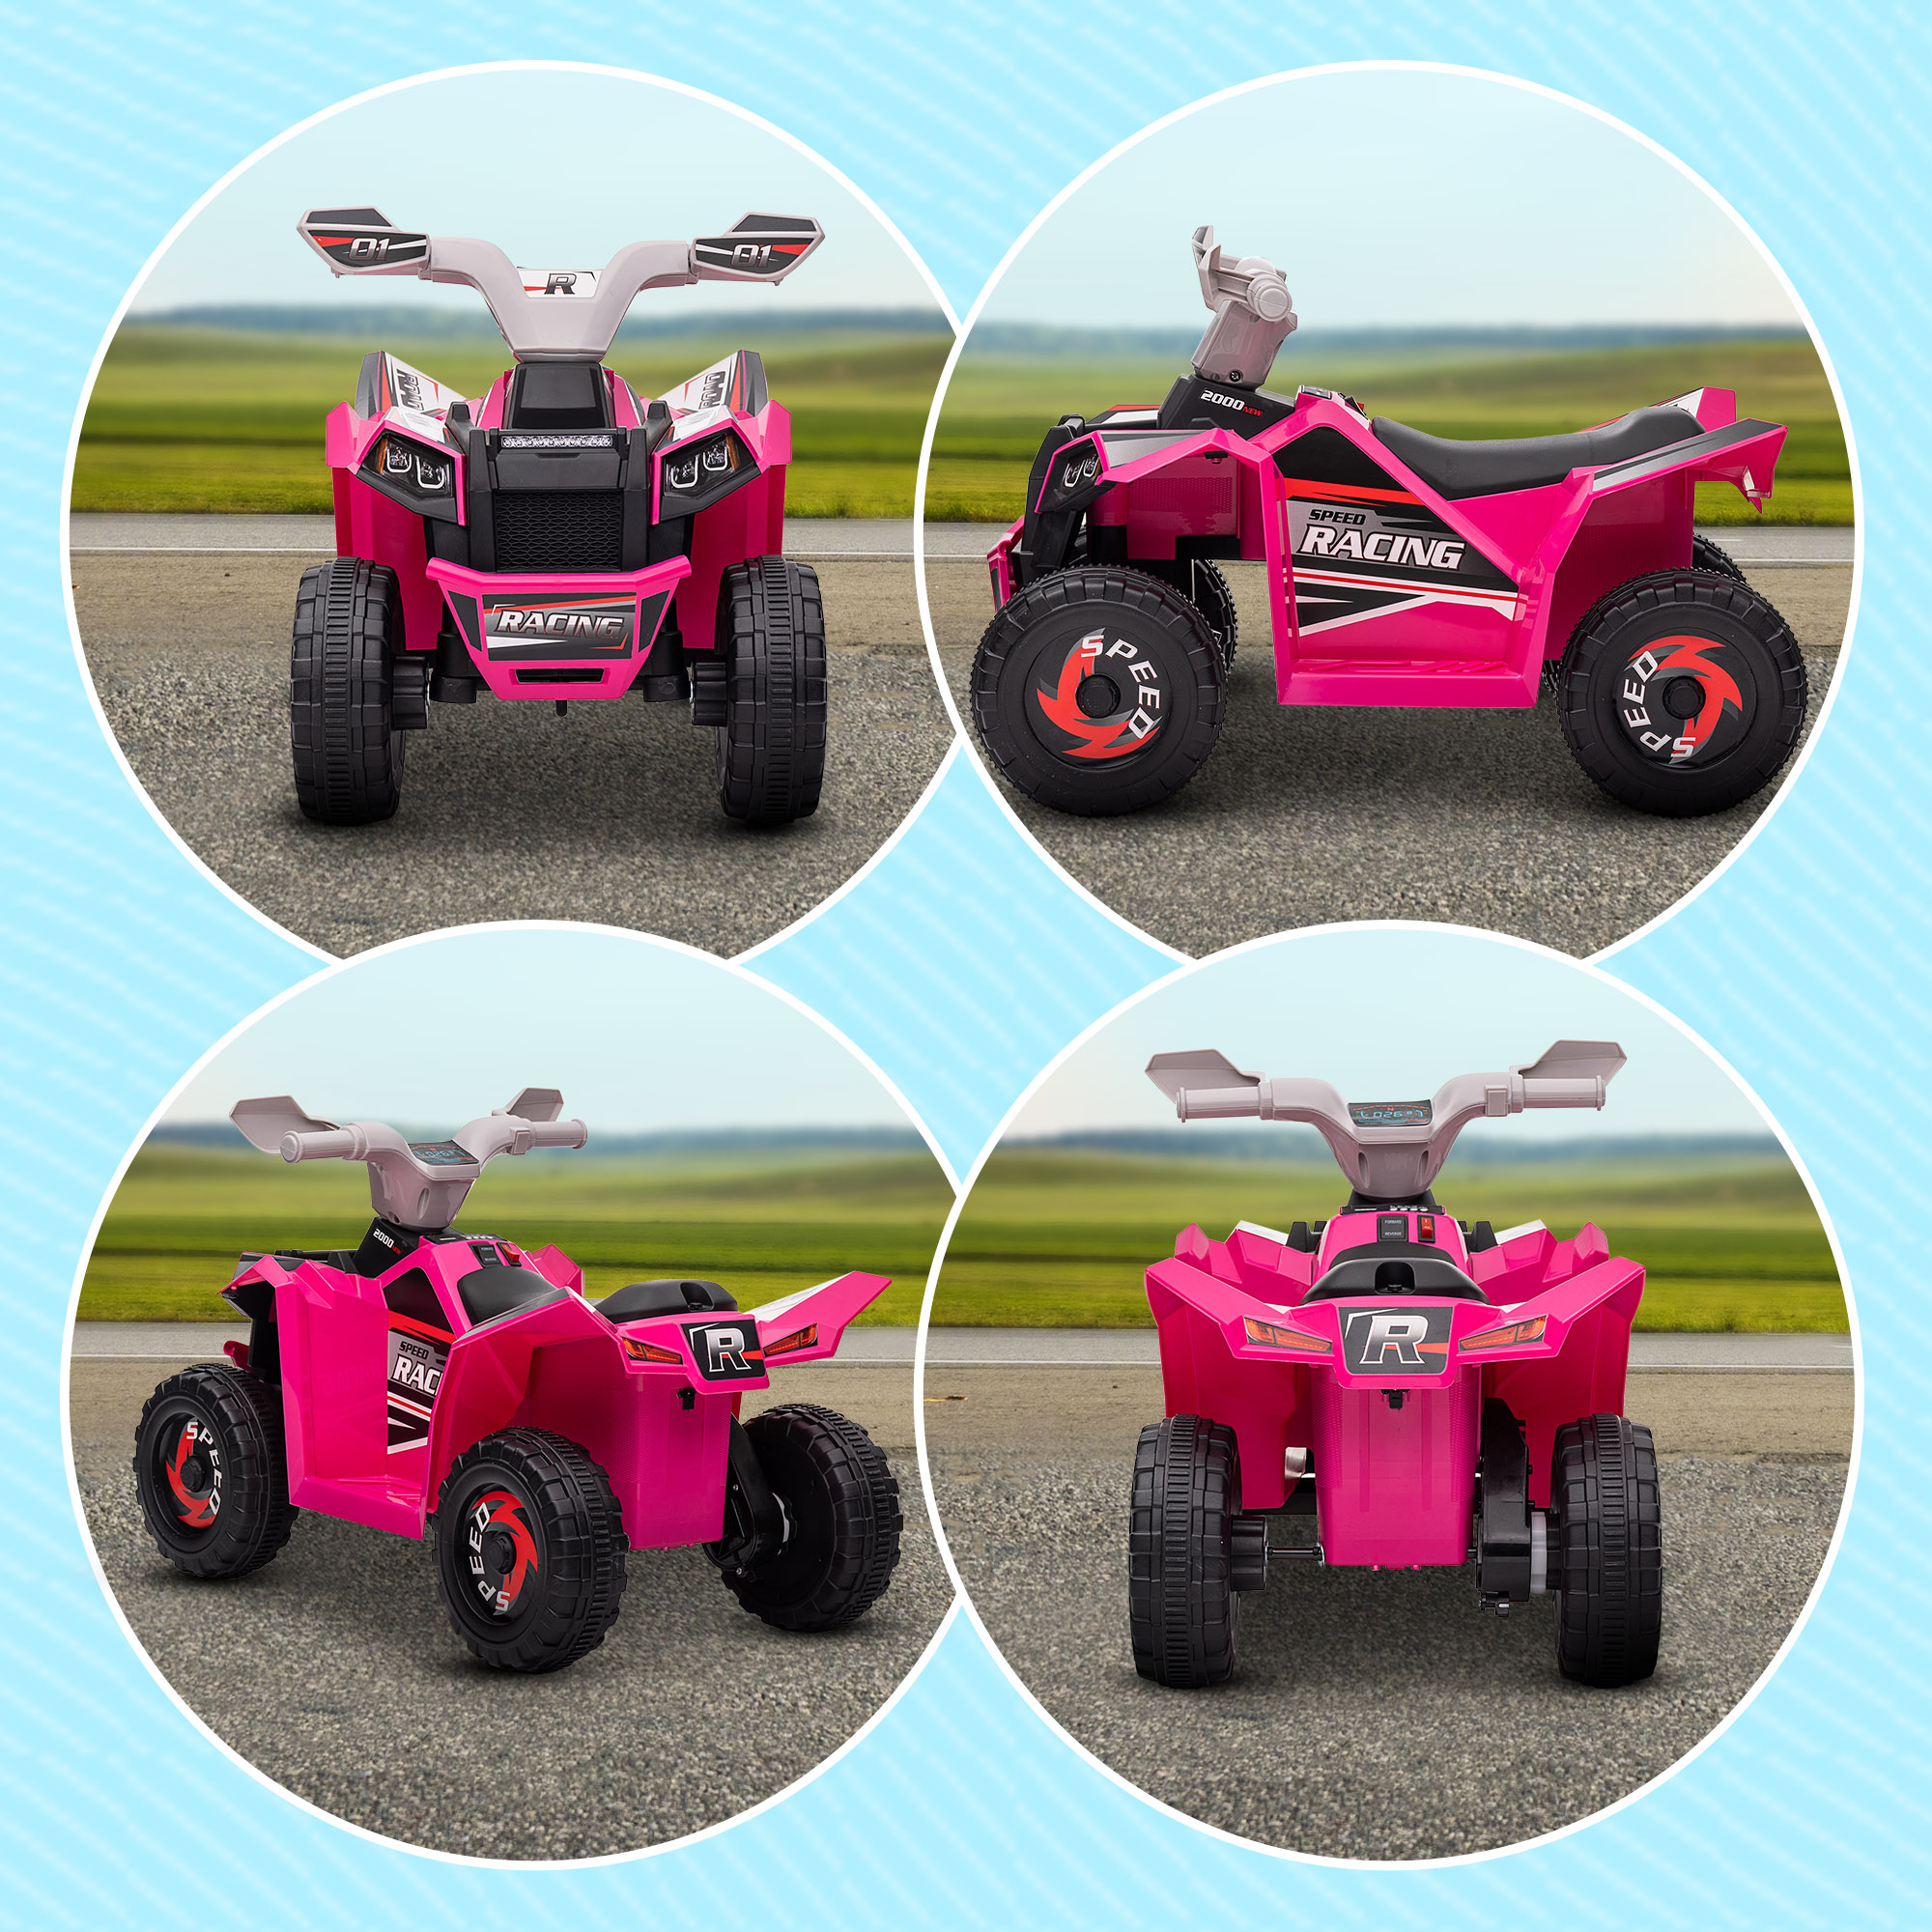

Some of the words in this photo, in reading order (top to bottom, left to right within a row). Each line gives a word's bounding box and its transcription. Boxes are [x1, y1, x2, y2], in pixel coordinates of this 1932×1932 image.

[349, 238, 390, 261] 01
[731, 244, 772, 268] 01
[544, 273, 577, 295] R
[396, 368, 425, 411] ROAD
[698, 371, 726, 410] ROAD
[1200, 389, 1245, 411] 2000
[1242, 406, 1264, 416] NEW
[1308, 509, 1367, 526] SPEED
[1296, 524, 1466, 571] RACING
[494, 610, 624, 639] RACING
[1081, 635, 1160, 739] SPEED
[1623, 650, 1696, 757] SPEED
[373, 1228, 394, 1249] 2000
[399, 1341, 430, 1360] SPEED
[705, 1327, 752, 1372] R
[1359, 1315, 1429, 1364] R
[186, 1421, 222, 1516] SPEED
[469, 1502, 511, 1612] SPEED
